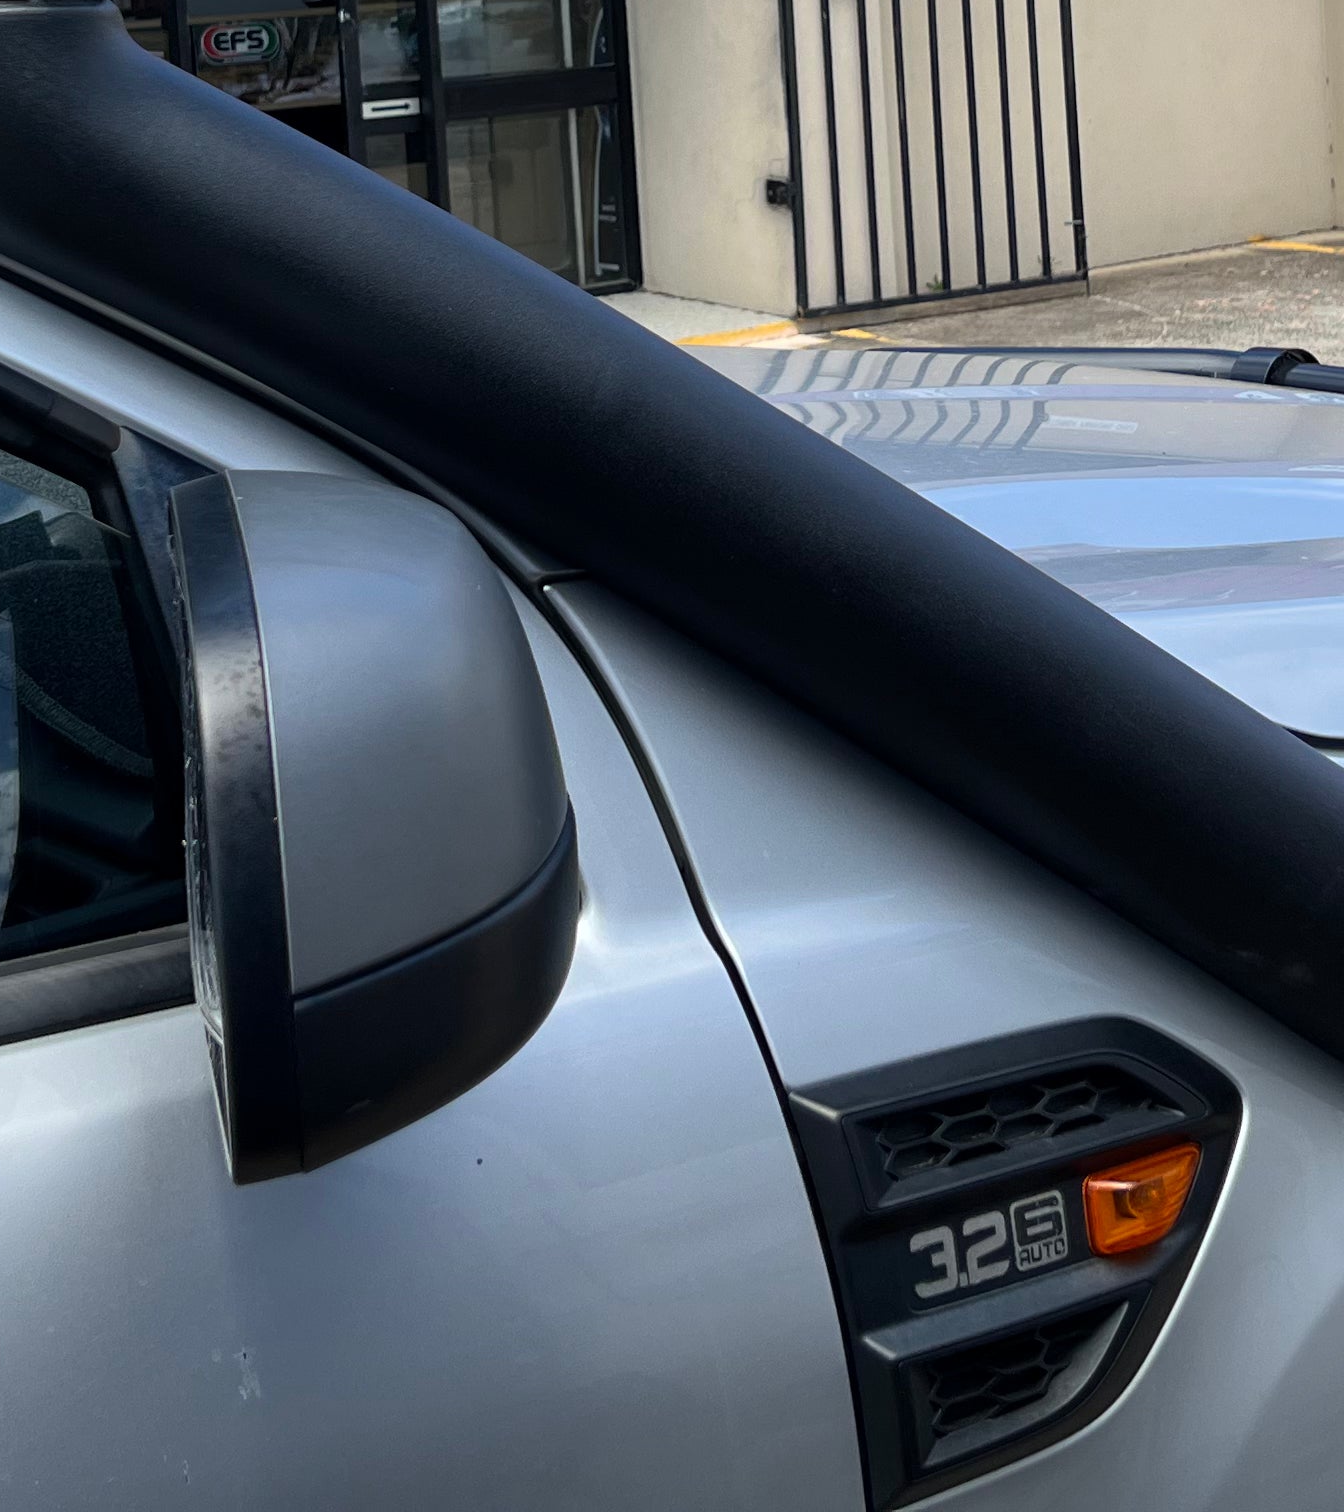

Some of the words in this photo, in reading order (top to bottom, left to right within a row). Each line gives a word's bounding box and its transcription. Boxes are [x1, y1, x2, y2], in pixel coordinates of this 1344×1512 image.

[213, 29, 265, 51] EFS
[910, 1210, 1010, 1299] 3.2
[1019, 1237, 1066, 1267] AUTO
